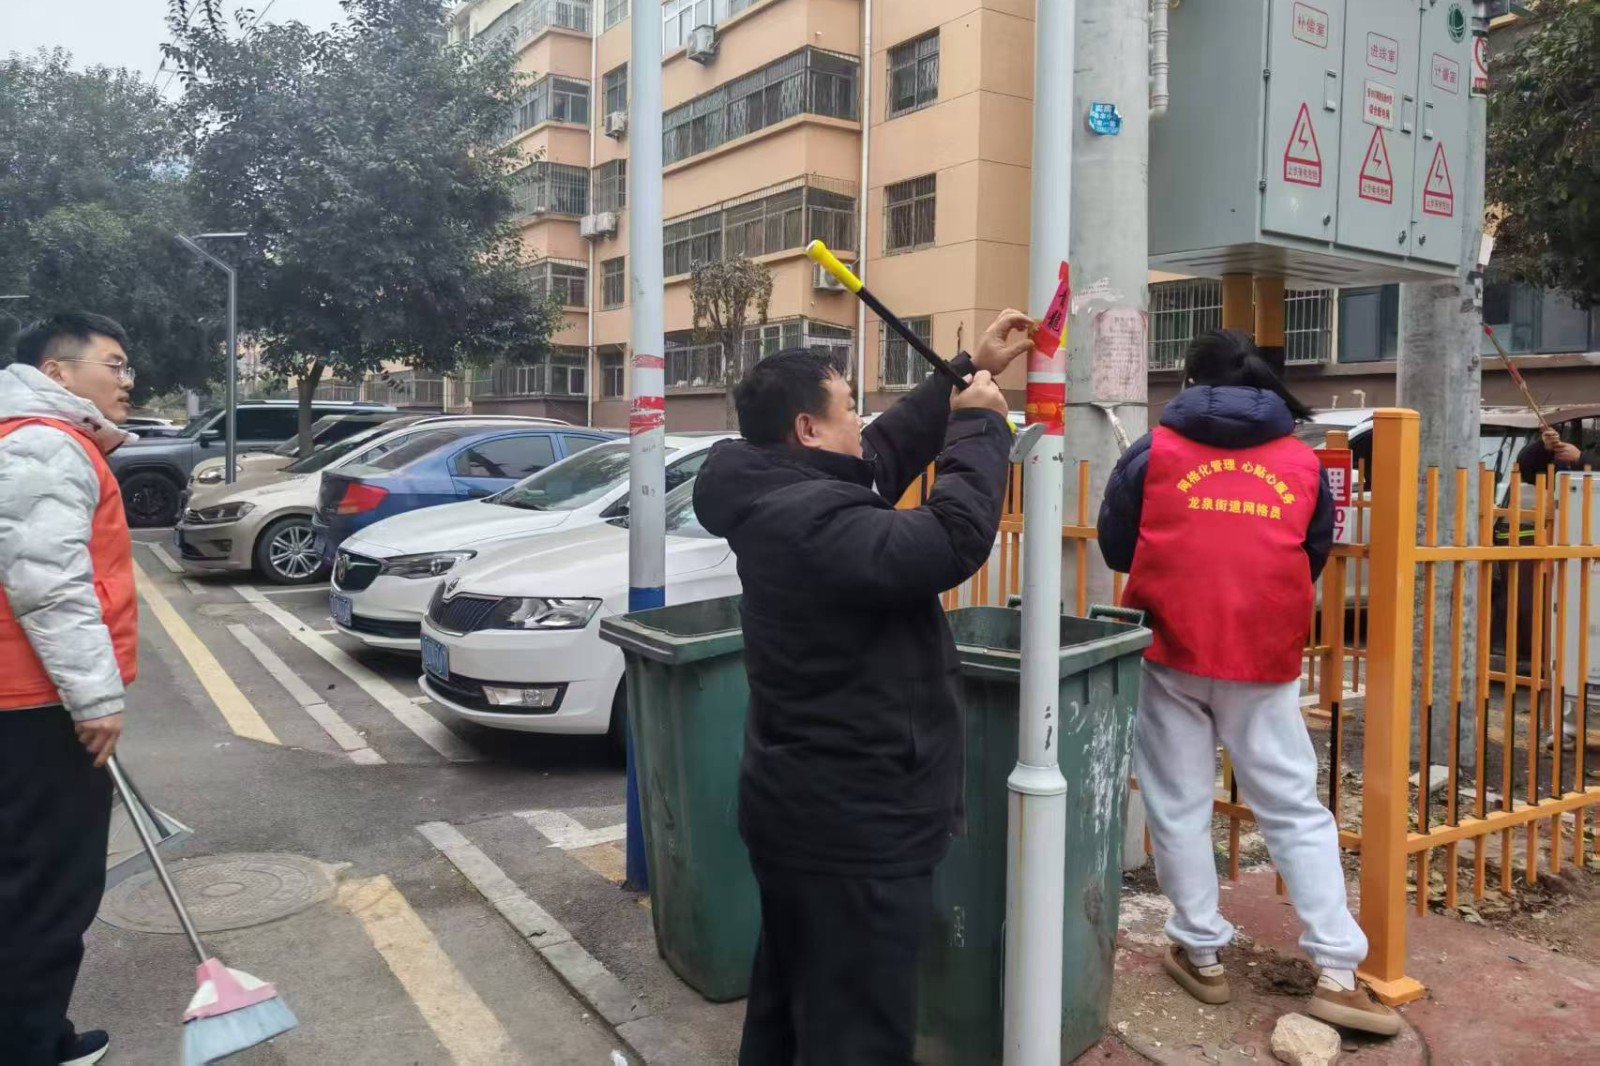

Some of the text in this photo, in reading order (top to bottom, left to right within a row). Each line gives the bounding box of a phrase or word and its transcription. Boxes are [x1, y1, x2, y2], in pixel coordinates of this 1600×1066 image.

[1177, 459, 1295, 504] 网格化管理 心贴心服务
[1188, 497, 1281, 520] 龙泉街道网格员
